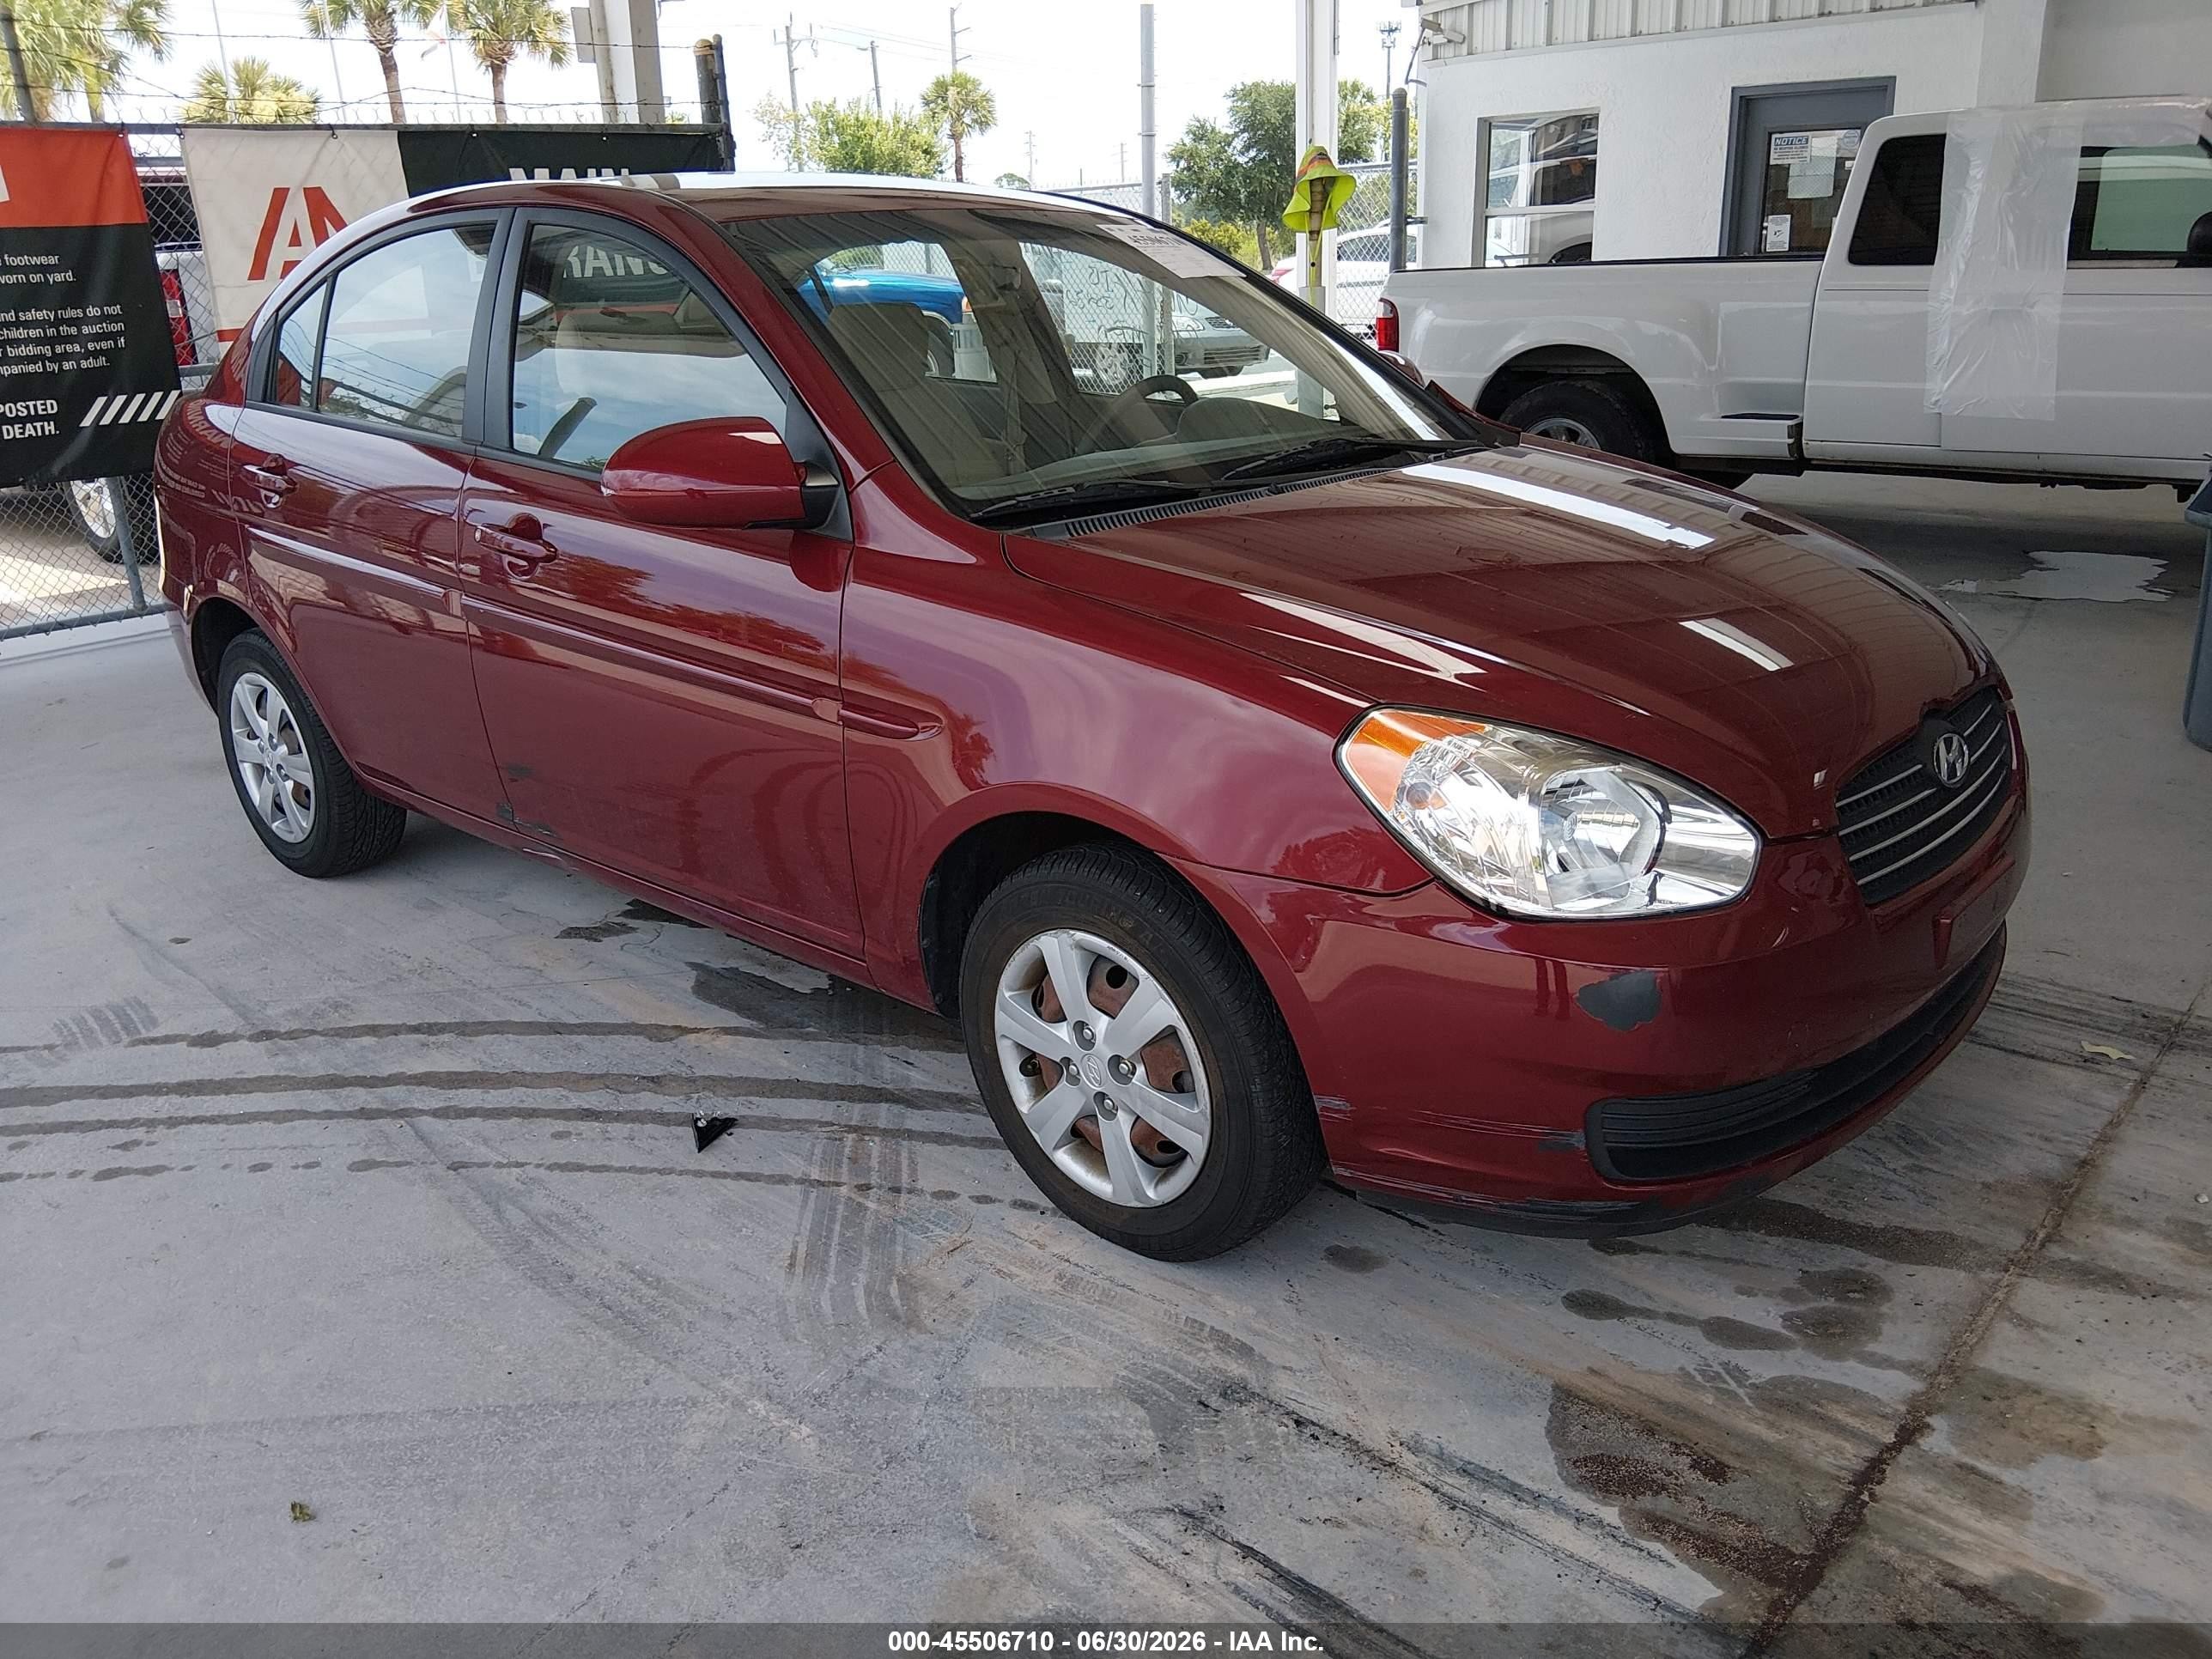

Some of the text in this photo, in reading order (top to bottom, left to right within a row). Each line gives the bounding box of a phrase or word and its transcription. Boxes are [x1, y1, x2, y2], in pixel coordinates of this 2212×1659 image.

[1775, 137, 1808, 146] NOTICE
[4, 254, 60, 266] footwear
[29, 274, 45, 283] on
[46, 270, 76, 285] yard.
[0, 304, 123, 322] nd safety rules do not
[46, 325, 57, 337] in
[59, 325, 78, 336] the
[82, 321, 125, 334] auction
[7, 343, 52, 357] bidding
[55, 343, 84, 354] area,
[88, 340, 114, 351] even
[117, 337, 125, 349] if
[46, 359, 59, 374] by
[63, 361, 77, 370] an
[80, 356, 110, 369] adult.
[2, 421, 60, 440] DEATH.
